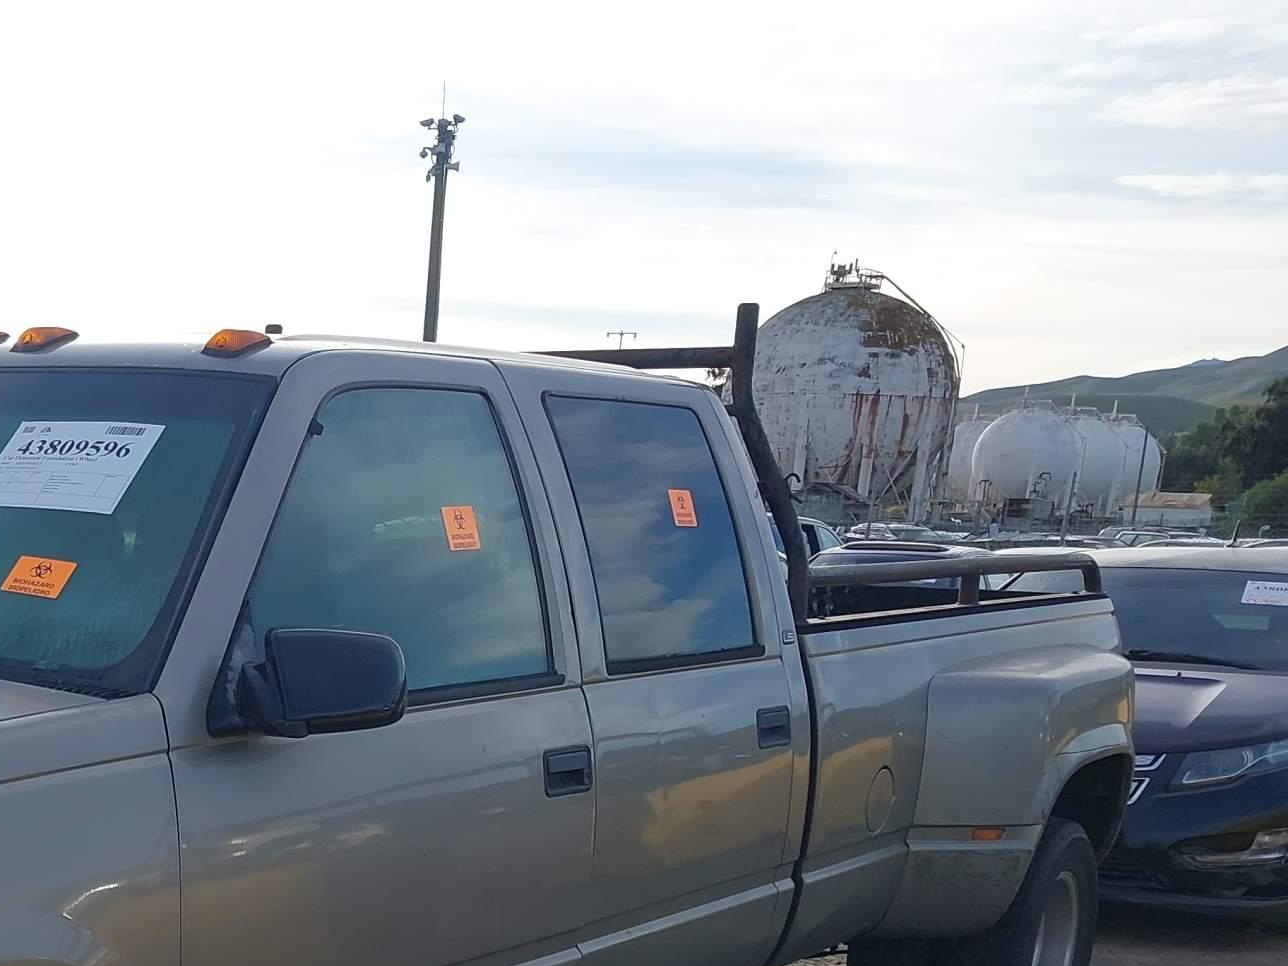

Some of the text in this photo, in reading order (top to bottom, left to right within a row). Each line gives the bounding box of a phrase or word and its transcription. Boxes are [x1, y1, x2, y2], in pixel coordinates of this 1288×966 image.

[16, 439, 135, 459] 43809596
[12, 578, 55, 589] BIOHAZARD
[8, 585, 51, 595] BIOPELIGRO
